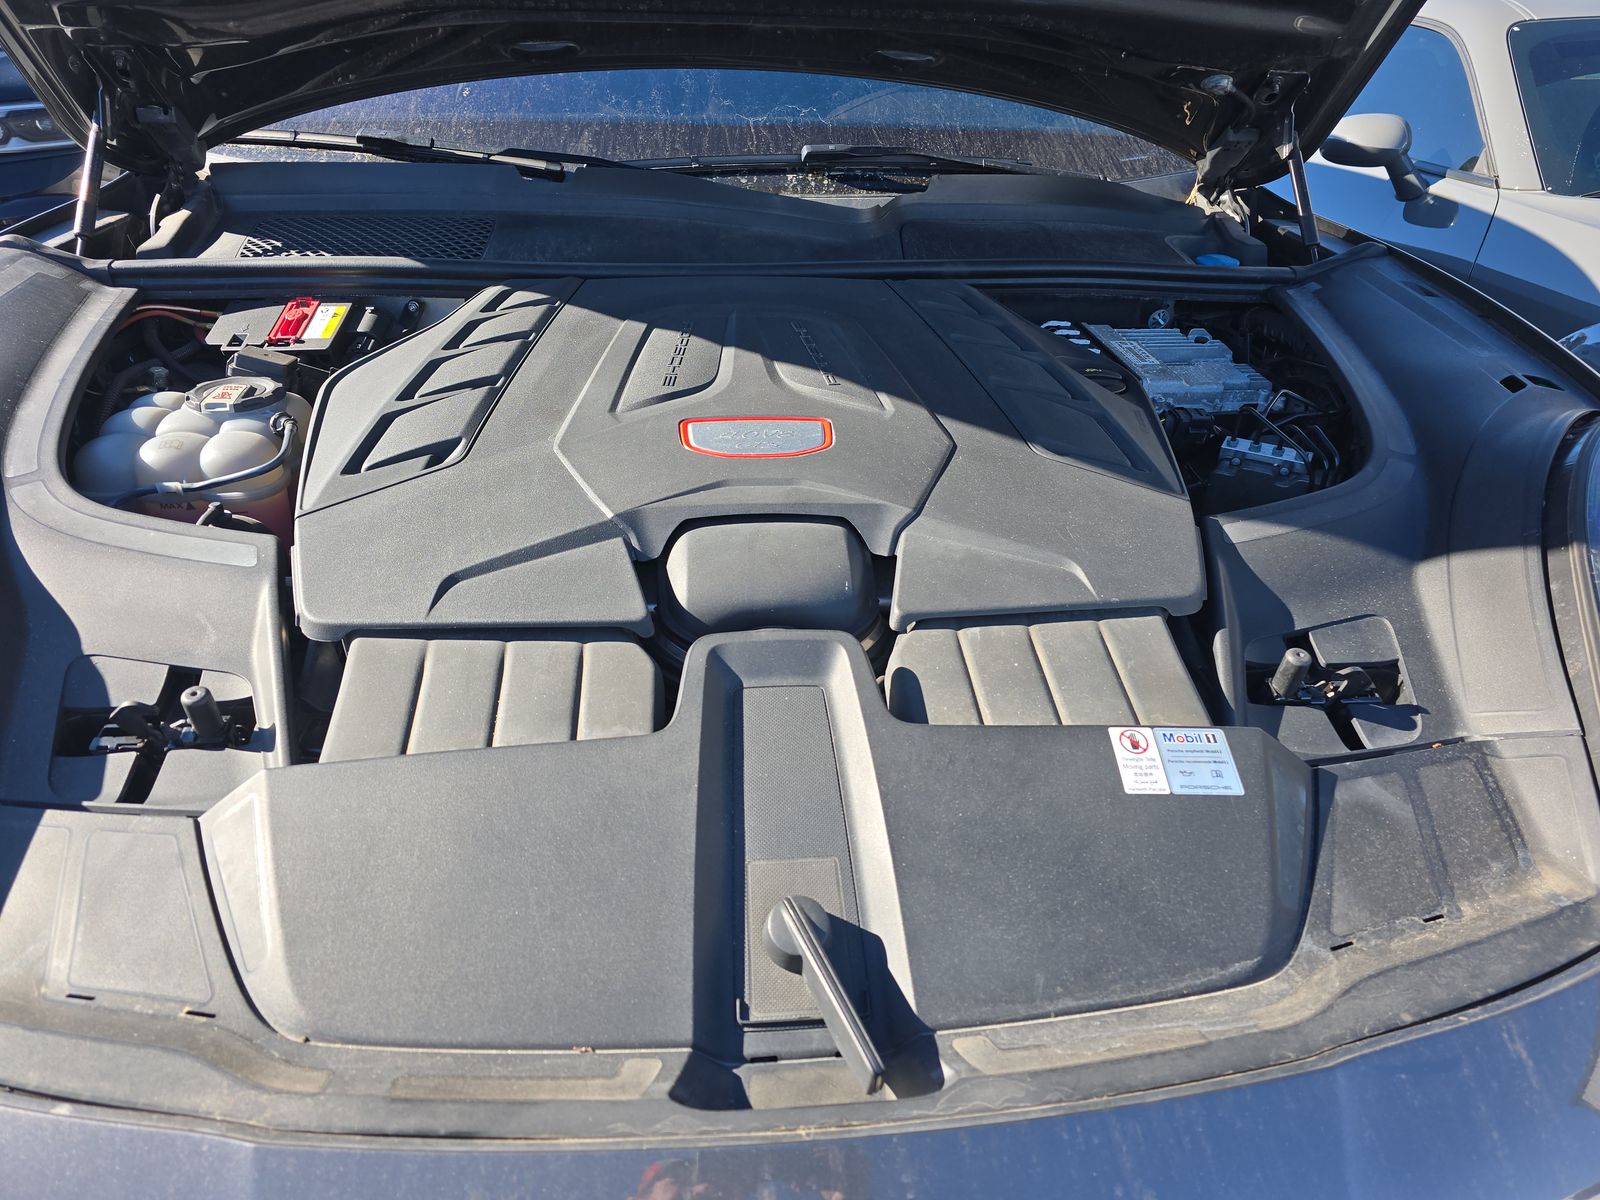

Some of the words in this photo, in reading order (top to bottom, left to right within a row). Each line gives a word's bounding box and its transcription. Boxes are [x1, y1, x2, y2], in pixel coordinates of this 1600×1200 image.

[160, 502, 184, 510] MAX
[1162, 732, 1203, 744] Mobil
[1205, 733, 1218, 744] 1
